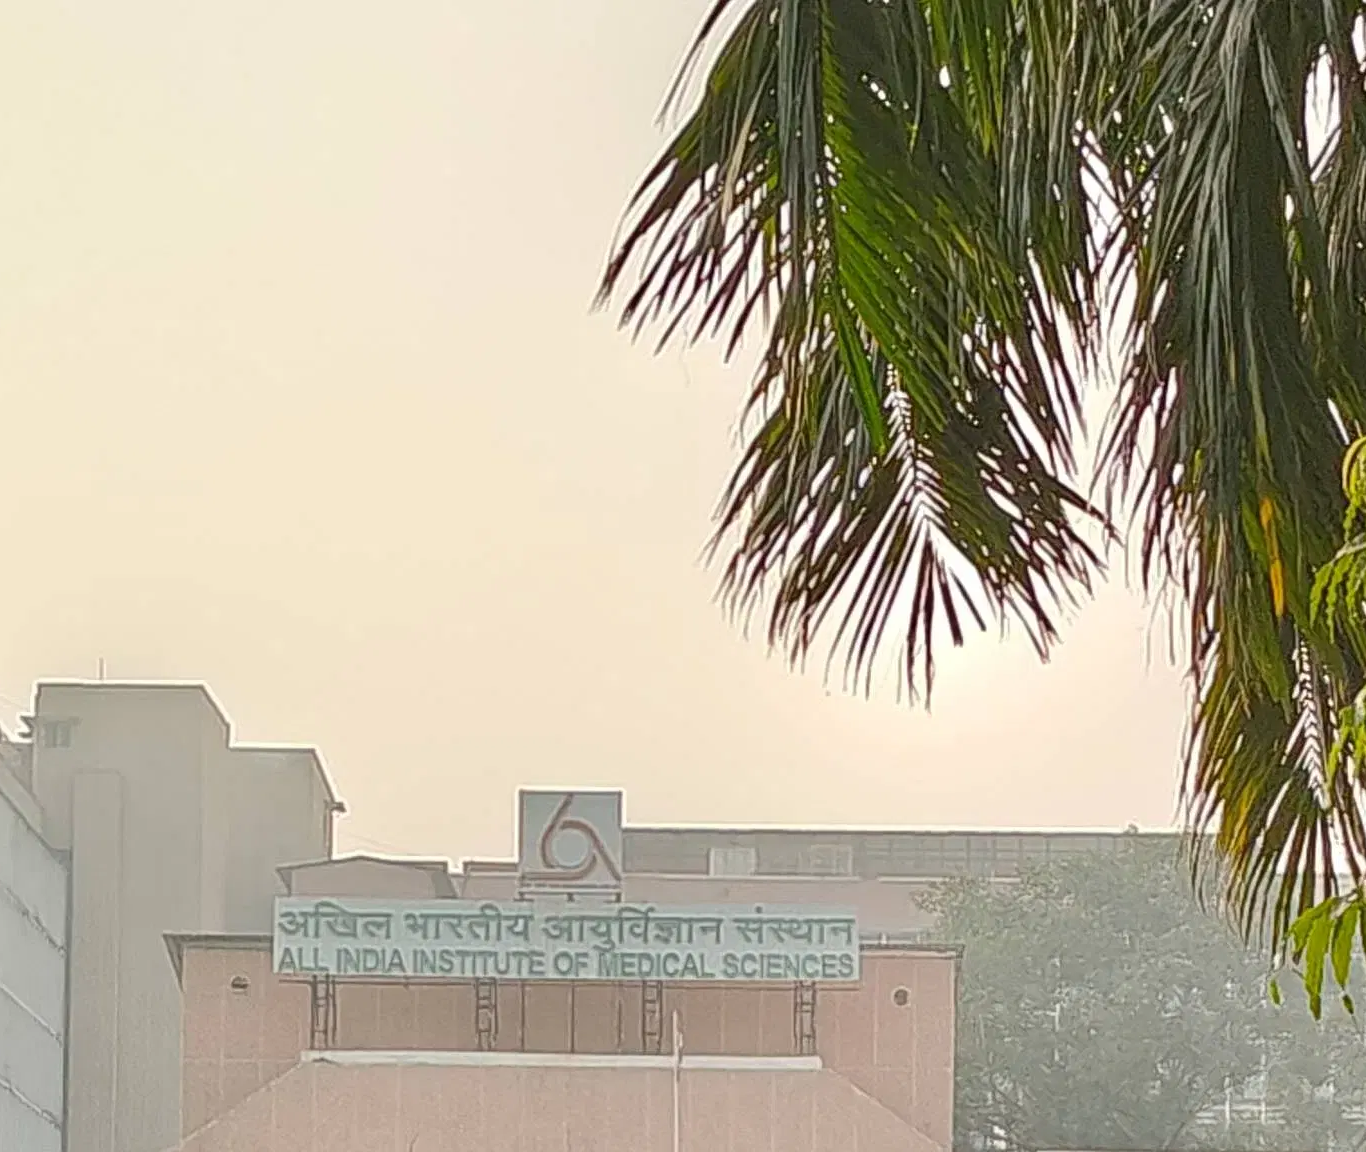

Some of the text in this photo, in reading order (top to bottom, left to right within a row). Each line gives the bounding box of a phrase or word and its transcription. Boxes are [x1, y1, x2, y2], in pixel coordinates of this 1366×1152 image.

[278, 901, 856, 952] अखिल भारतीय आयुर्विज्ञान संस्थान
[278, 947, 854, 979] ALL INDIA INSTITUTE OF MEDICAL SCIENCES
